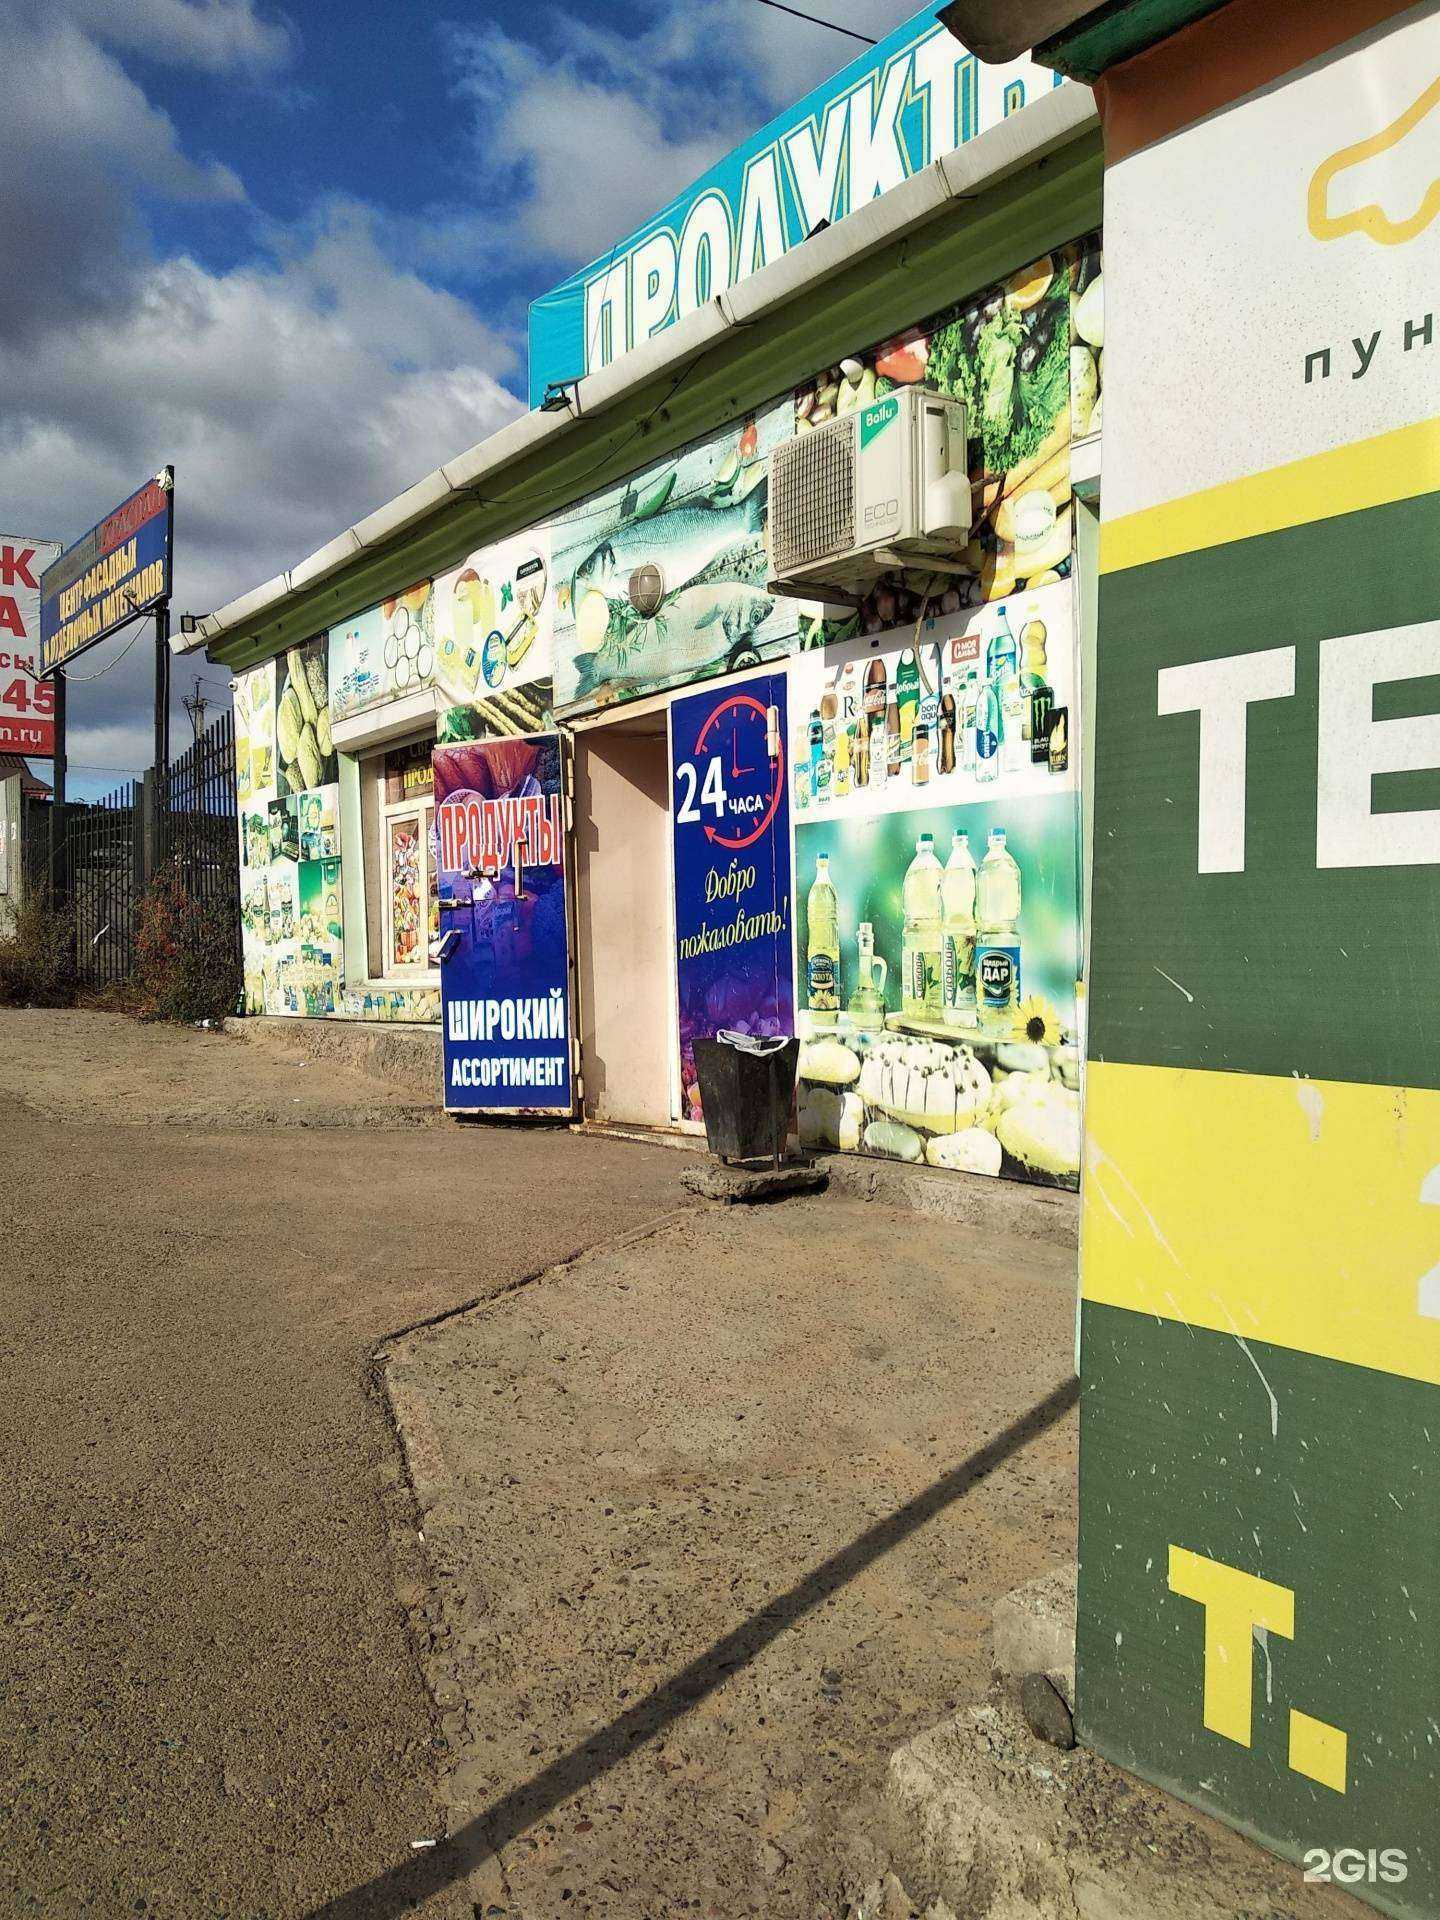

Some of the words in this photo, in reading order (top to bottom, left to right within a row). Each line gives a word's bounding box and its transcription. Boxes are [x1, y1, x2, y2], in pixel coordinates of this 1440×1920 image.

[866, 403, 893, 427] Ballu
[865, 499, 899, 523] ECO
[59, 578, 83, 623] ЦЕНТР
[84, 536, 137, 602] ФАСАДНЫХ
[676, 756, 727, 823] 24
[729, 795, 764, 815] ЧАСА
[440, 794, 561, 882] ПРОДУКТЫ
[704, 858, 756, 903] Добро
[680, 896, 788, 960] пожаловать!
[983, 967, 1009, 982] ДАР
[447, 988, 565, 1041] ШИРОКИЙ
[451, 1056, 564, 1086] АССОРТИМЕНТ
